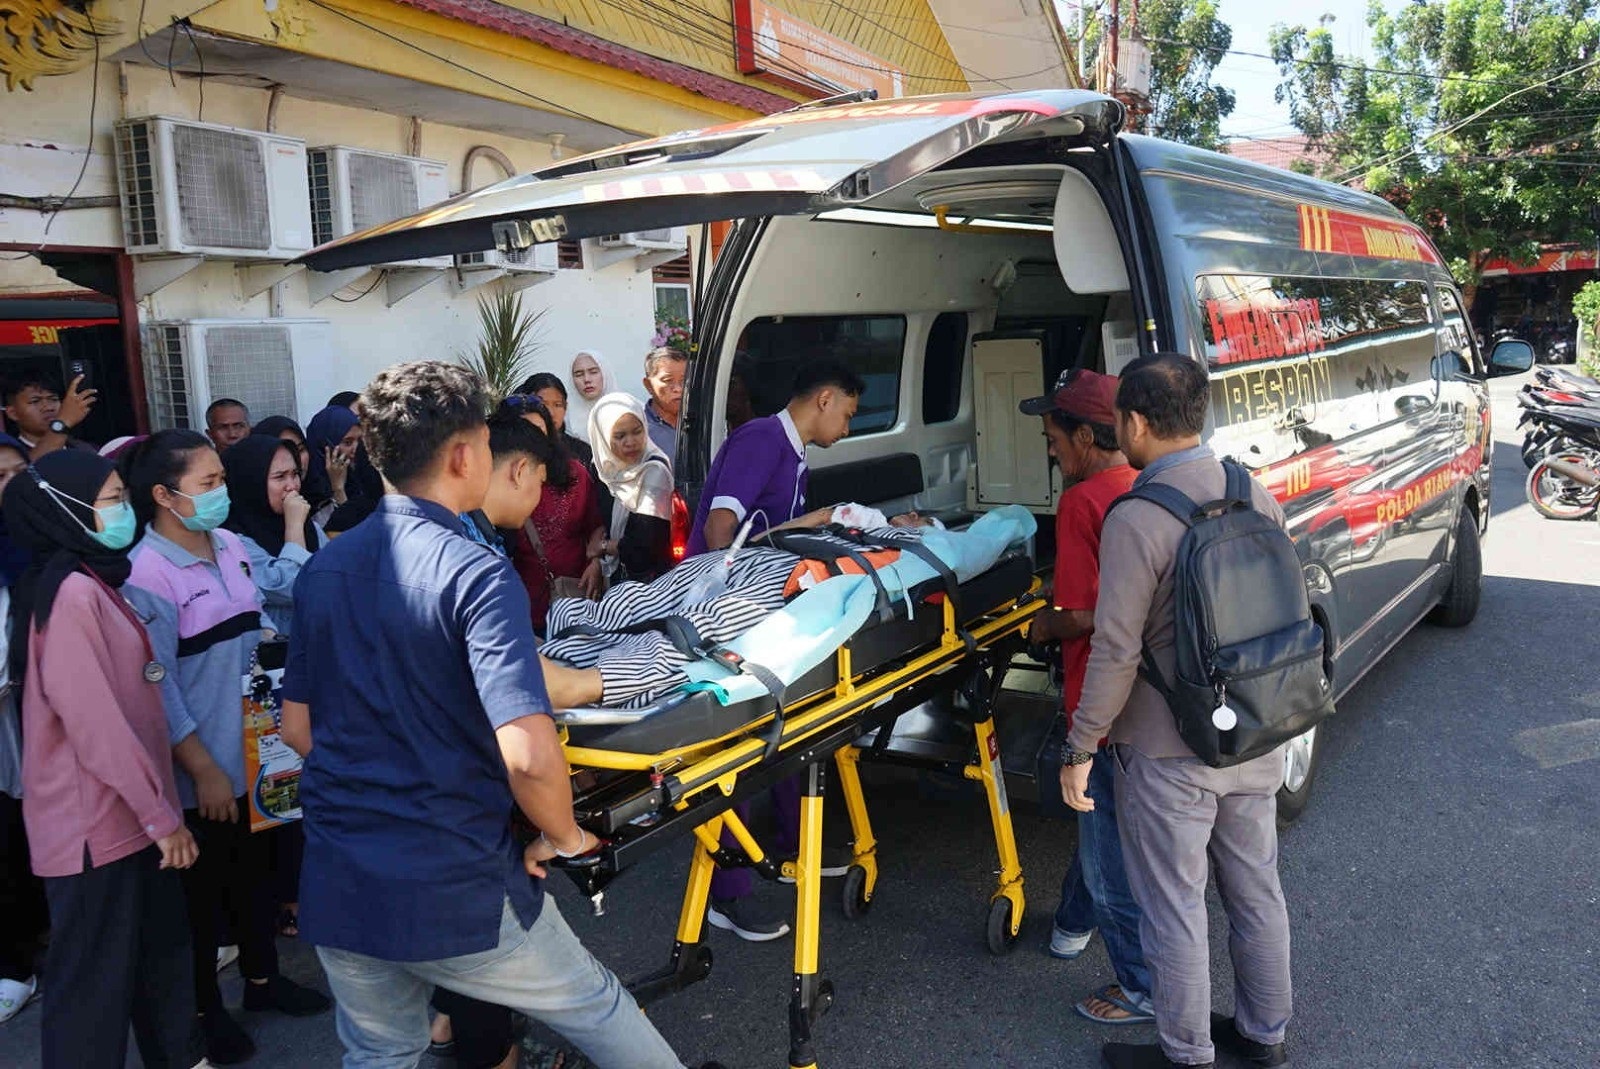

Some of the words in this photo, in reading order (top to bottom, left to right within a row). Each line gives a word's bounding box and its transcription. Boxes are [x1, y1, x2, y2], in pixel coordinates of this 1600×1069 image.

[1223, 357, 1332, 428] RESPON
[1377, 485, 1422, 526] POLDA
[1424, 468, 1452, 502] RIAU
